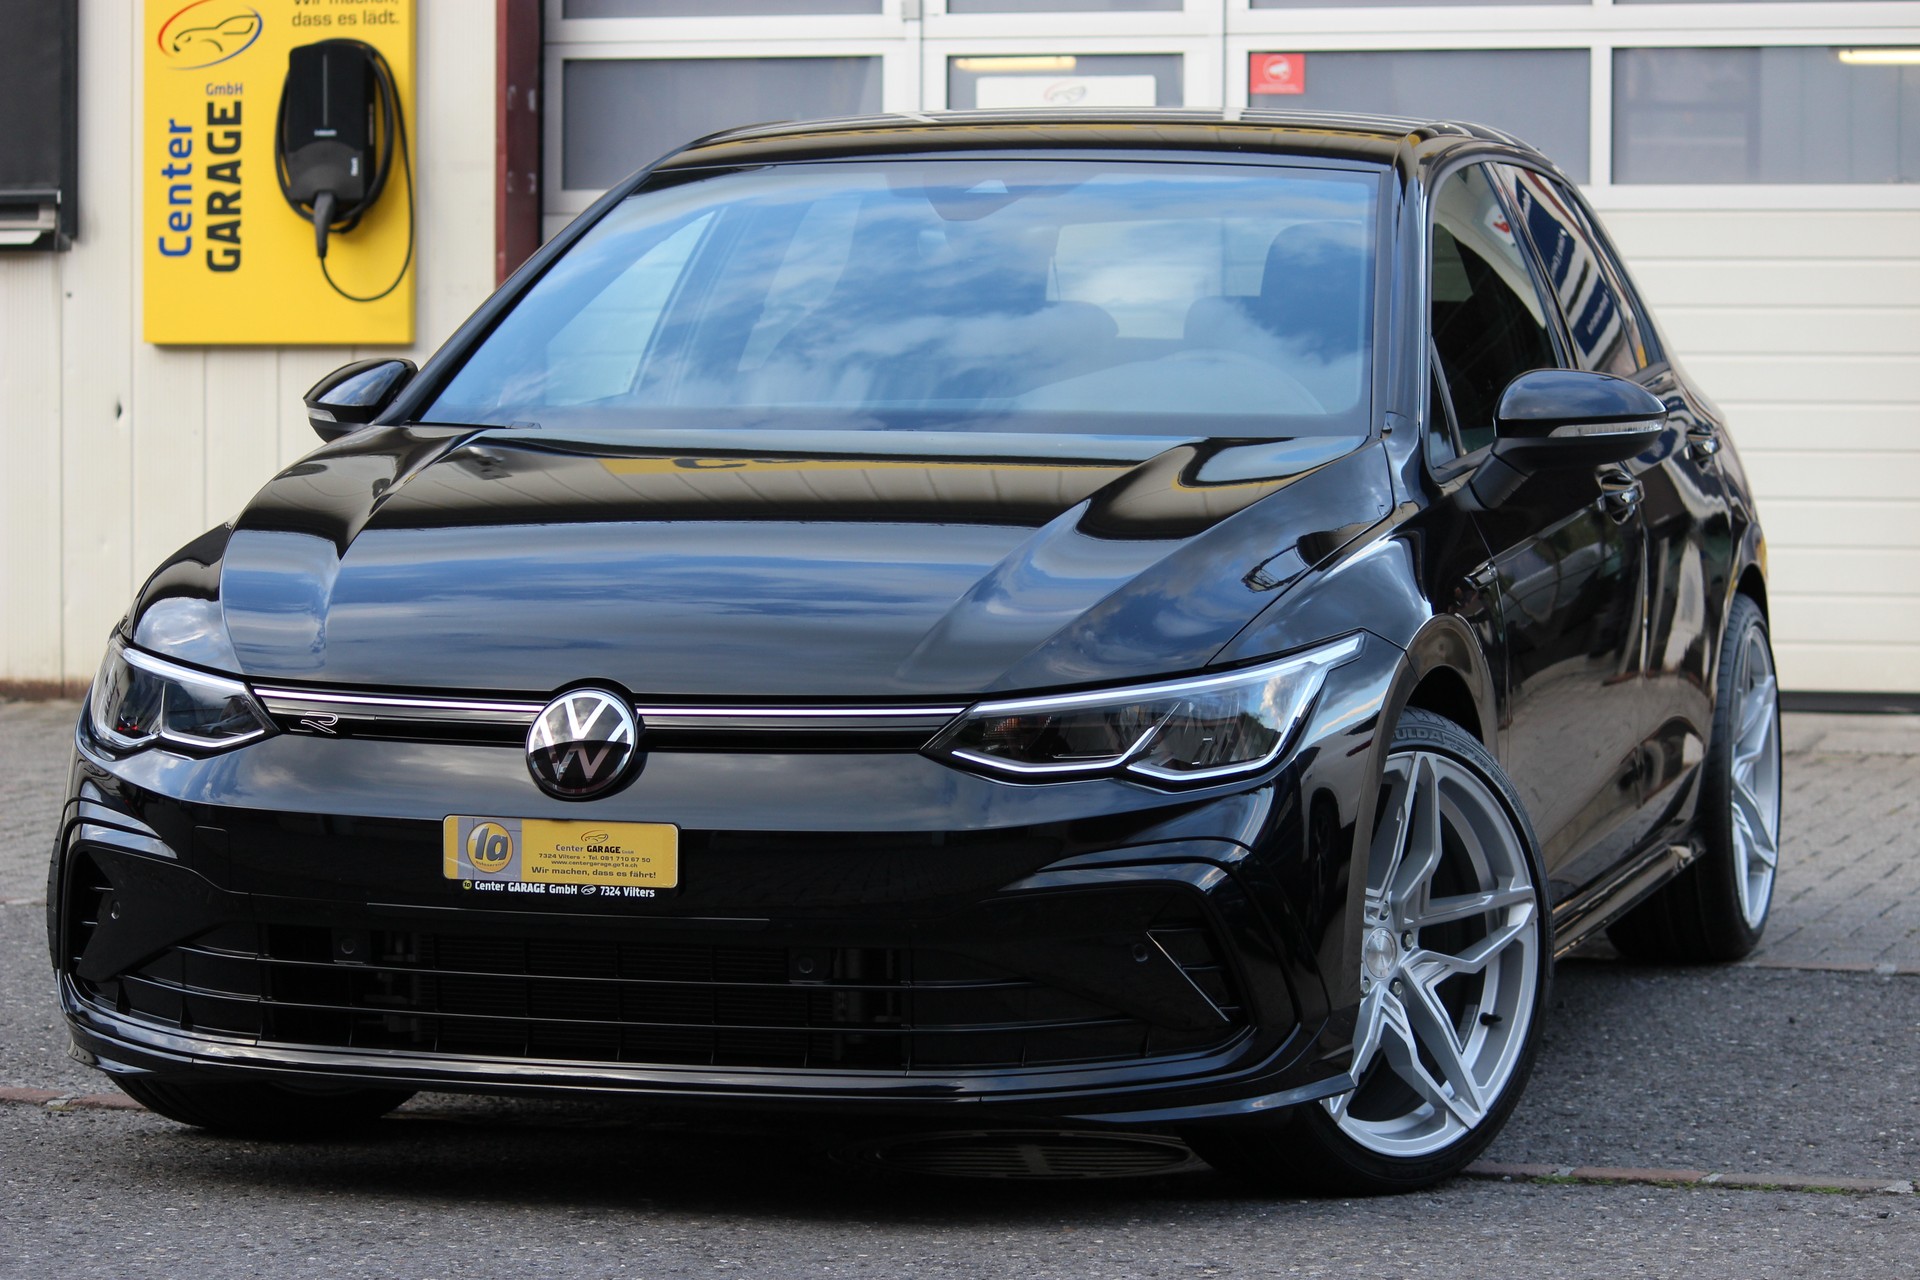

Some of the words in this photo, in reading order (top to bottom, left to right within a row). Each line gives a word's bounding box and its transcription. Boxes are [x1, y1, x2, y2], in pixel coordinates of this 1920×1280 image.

[291, 12, 332, 27] dass
[337, 13, 358, 26] es
[363, 9, 399, 25] lädt.
[206, 83, 243, 96] GmbH
[159, 119, 193, 257] Center
[206, 101, 242, 272] GARAGE
[1394, 728, 1442, 743] ULDA
[556, 844, 583, 853] Center
[586, 845, 621, 854] GARAGE
[531, 866, 549, 874] Wir
[551, 867, 590, 877] machen,
[592, 869, 614, 877] dass
[629, 871, 656, 879] fährt!
[474, 880, 505, 891] Center
[507, 882, 546, 894] GARAGE
[549, 884, 578, 895] GmbH
[600, 886, 621, 897] 7324
[623, 887, 655, 898] Vilters
